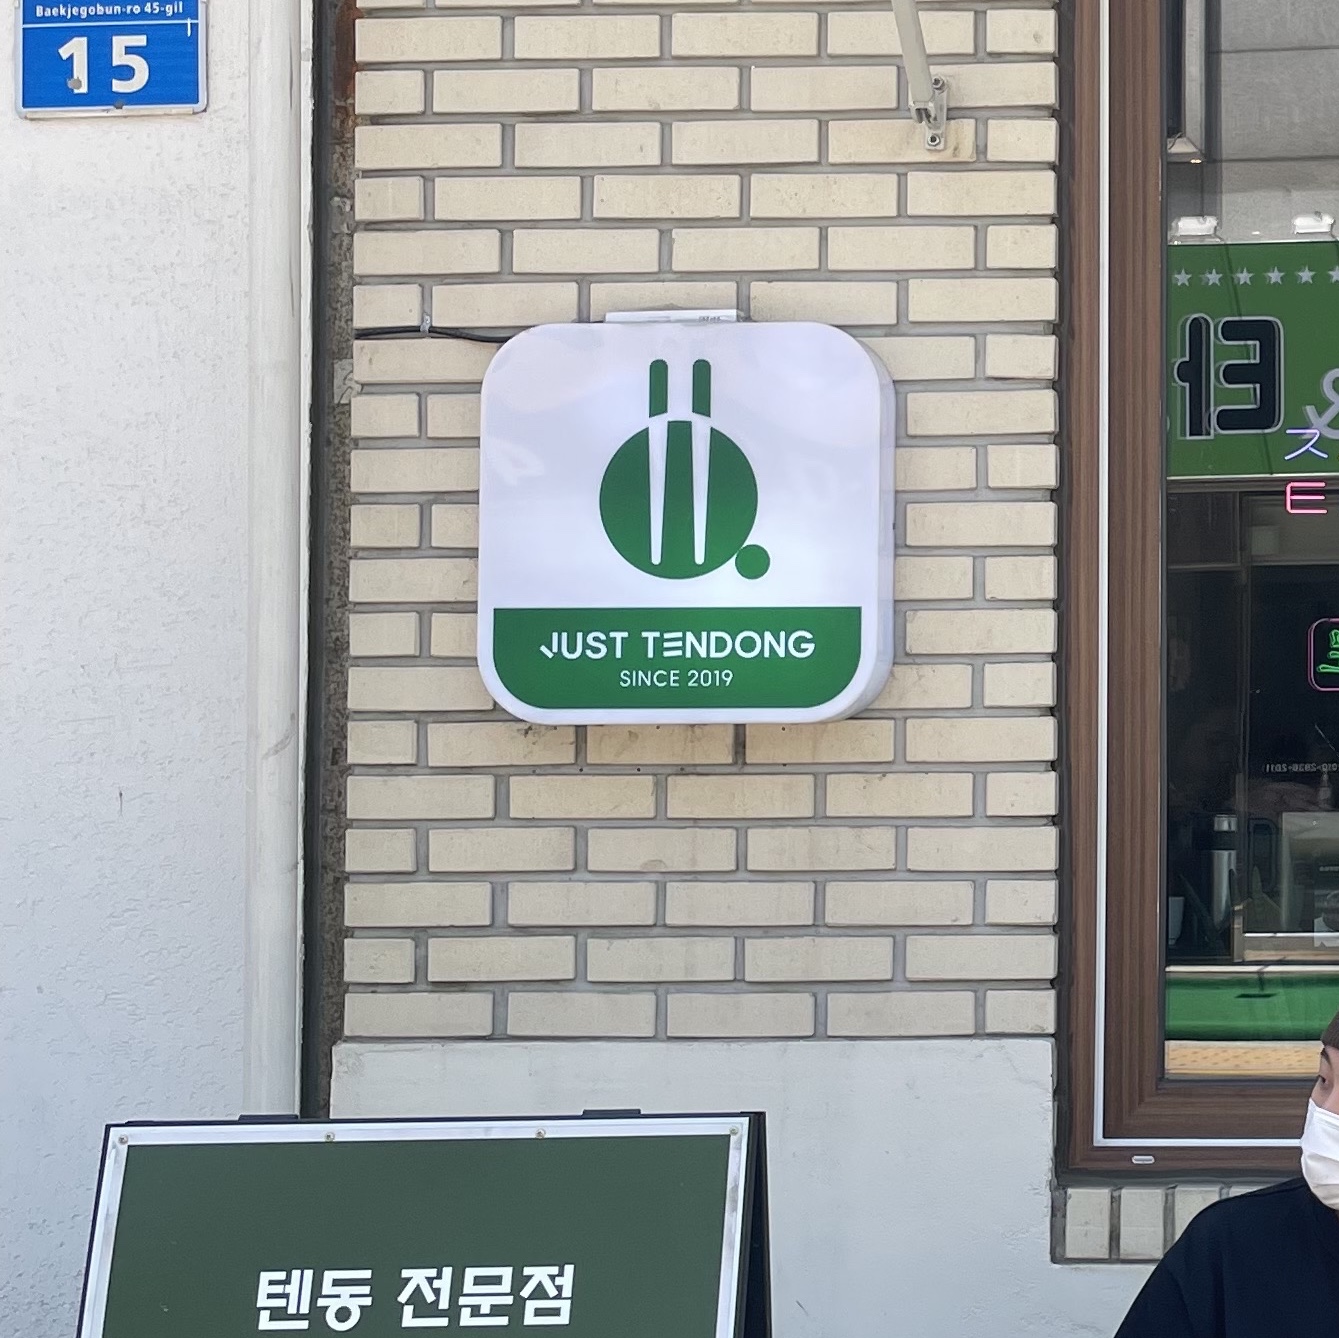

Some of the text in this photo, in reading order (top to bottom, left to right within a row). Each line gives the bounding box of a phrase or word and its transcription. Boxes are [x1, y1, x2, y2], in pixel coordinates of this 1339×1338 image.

[36, 1, 183, 19] Baekjegobun-ro 45-gil
[58, 34, 149, 94] 15
[539, 630, 816, 660] JUST TENDONG
[619, 669, 734, 688] SINCE 2019
[256, 1264, 575, 1331] 텐동 전문점
